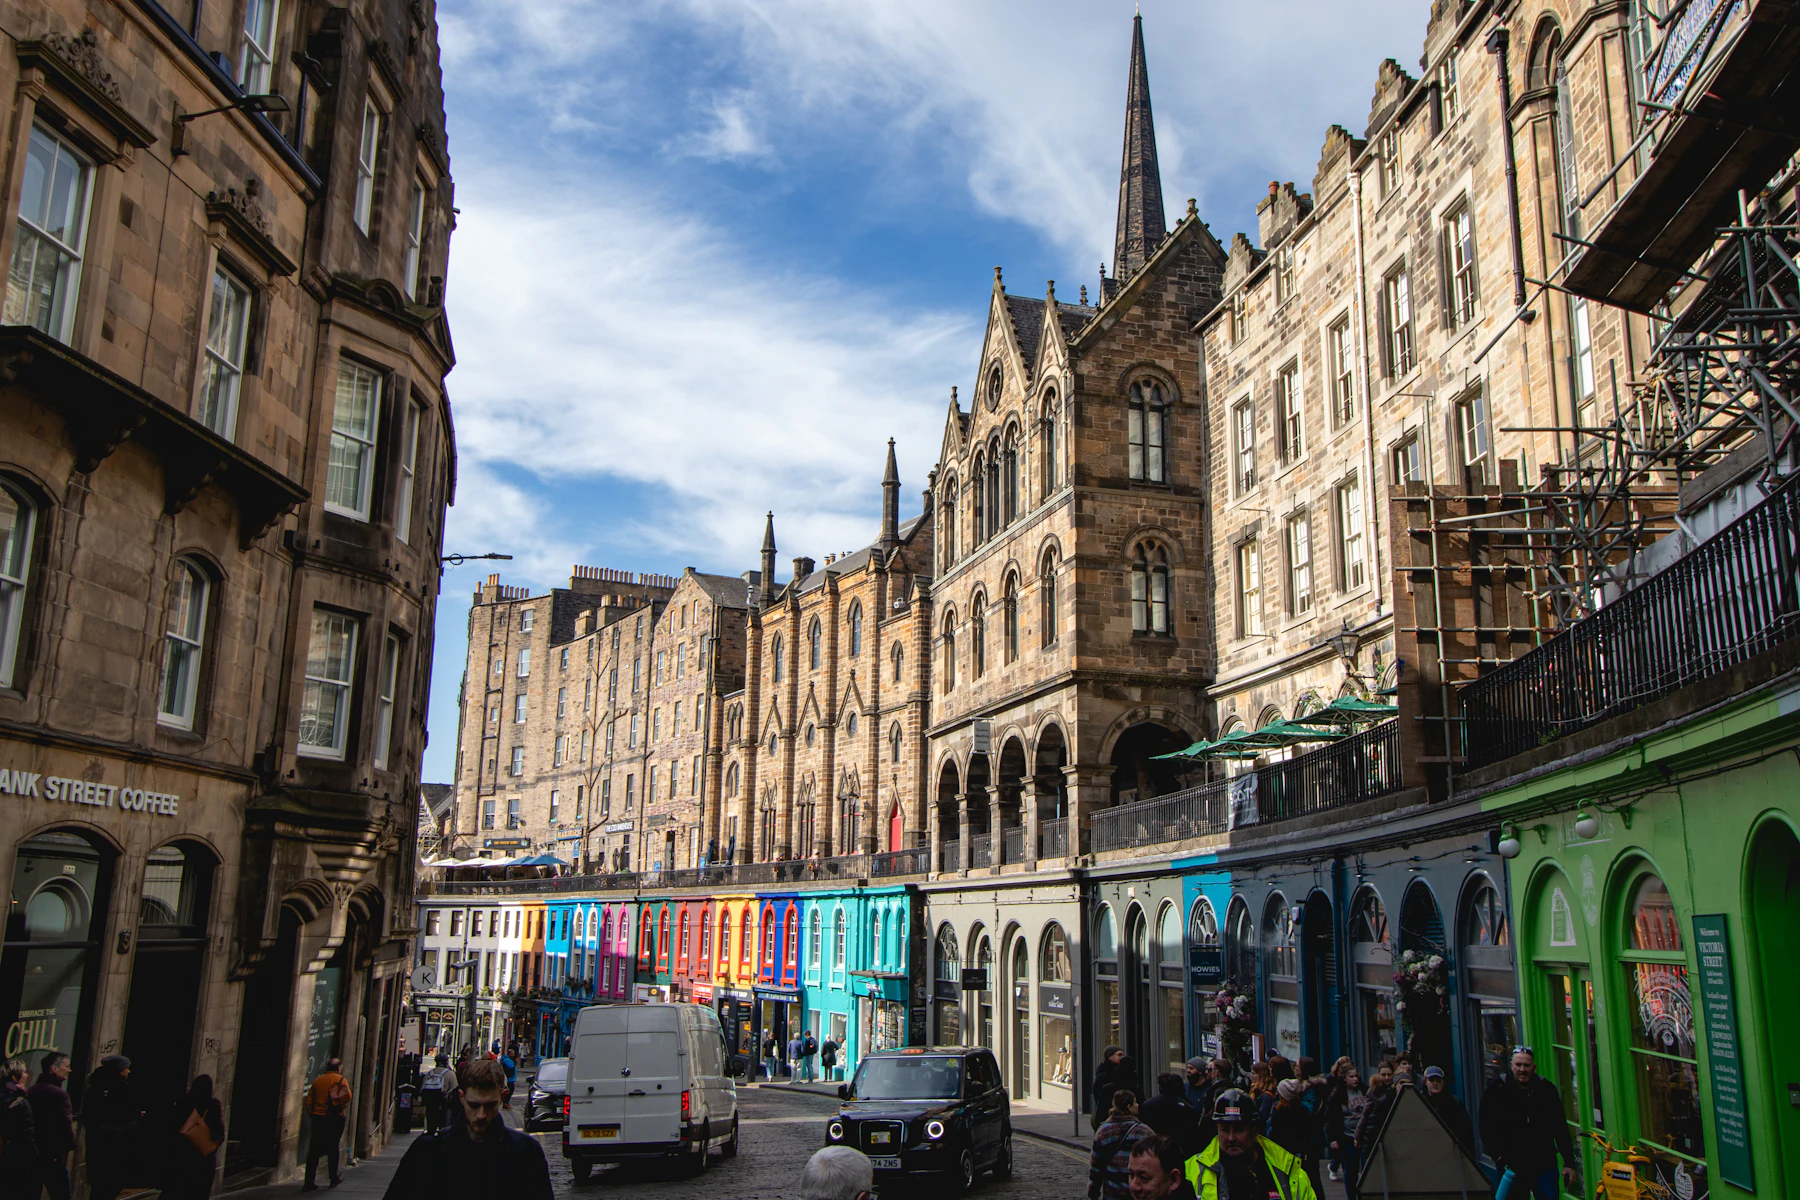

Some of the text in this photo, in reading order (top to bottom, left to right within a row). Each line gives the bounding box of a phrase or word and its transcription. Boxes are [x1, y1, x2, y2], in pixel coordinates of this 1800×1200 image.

[44, 776, 118, 807] STREET
[119, 787, 180, 815] COFFEE
[1698, 942, 1724, 952] VICTORIA
[1703, 956, 1723, 966] STREET
[422, 973, 433, 984] K
[18, 1008, 56, 1019] EMBRACE THE
[4, 1018, 59, 1059] CHILL
